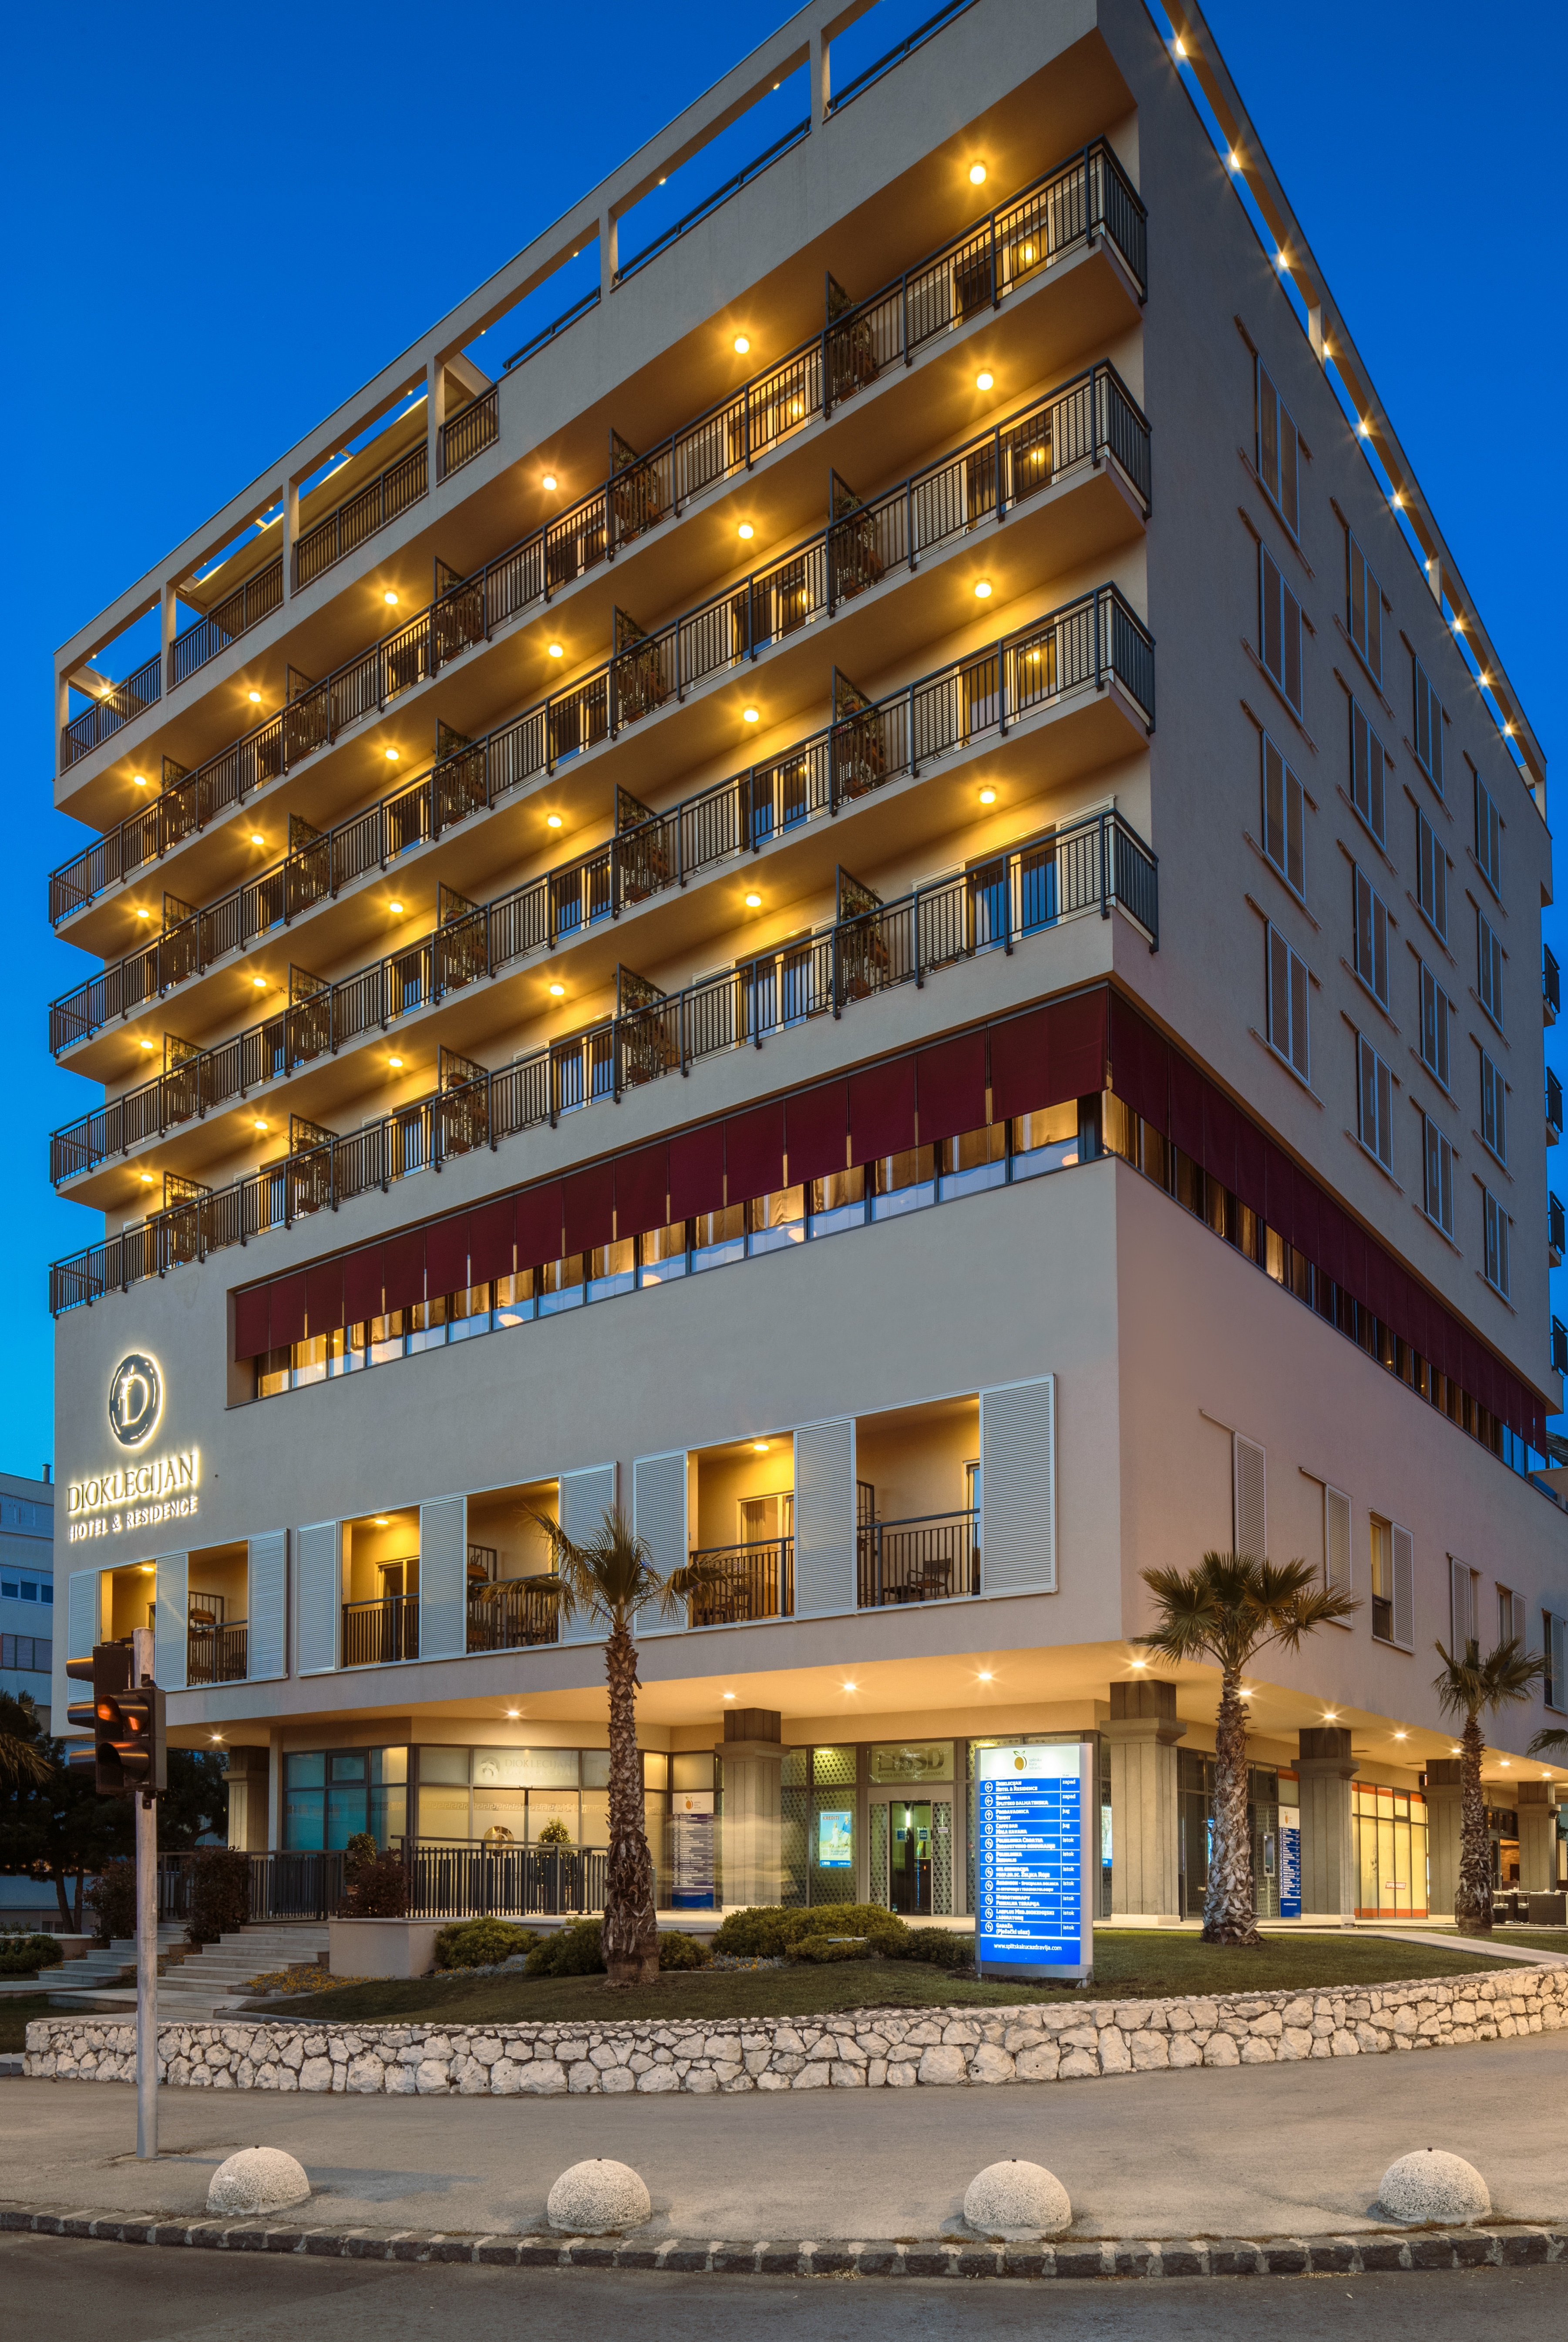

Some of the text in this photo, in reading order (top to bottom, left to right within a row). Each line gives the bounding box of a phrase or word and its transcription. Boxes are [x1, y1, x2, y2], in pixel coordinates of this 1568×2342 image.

[67, 1454, 195, 1512] DIOKLECIJAN
[68, 1497, 199, 1541] HOTEL & RESIDENCE
[505, 1759, 572, 1768] DIOKLECIJAN
